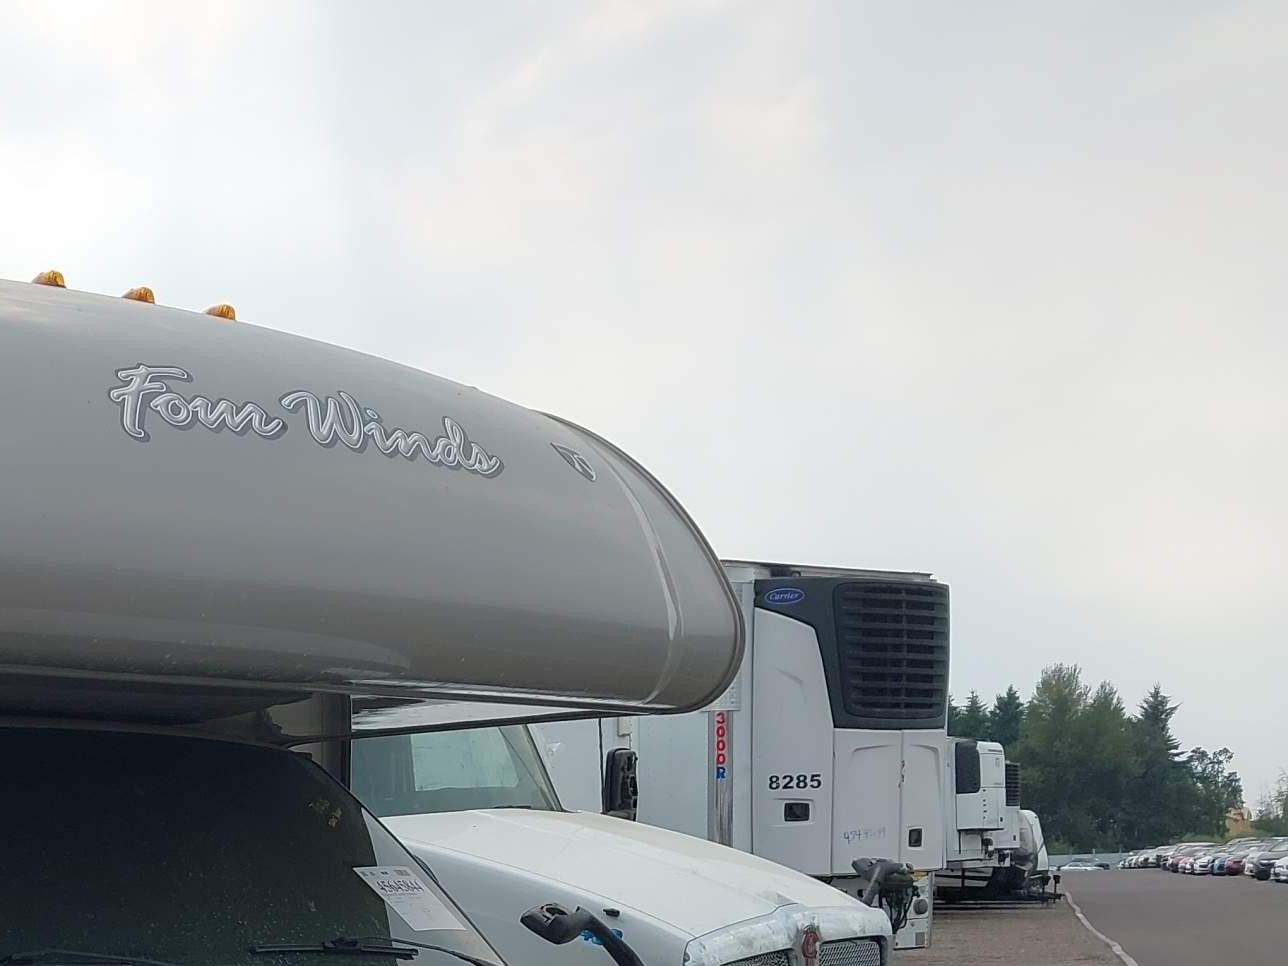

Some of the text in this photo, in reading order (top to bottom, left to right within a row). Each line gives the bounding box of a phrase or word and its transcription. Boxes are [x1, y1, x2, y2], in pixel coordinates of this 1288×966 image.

[109, 364, 503, 476] Four Winds
[769, 591, 800, 601] Carrier
[768, 774, 822, 790] 8285
